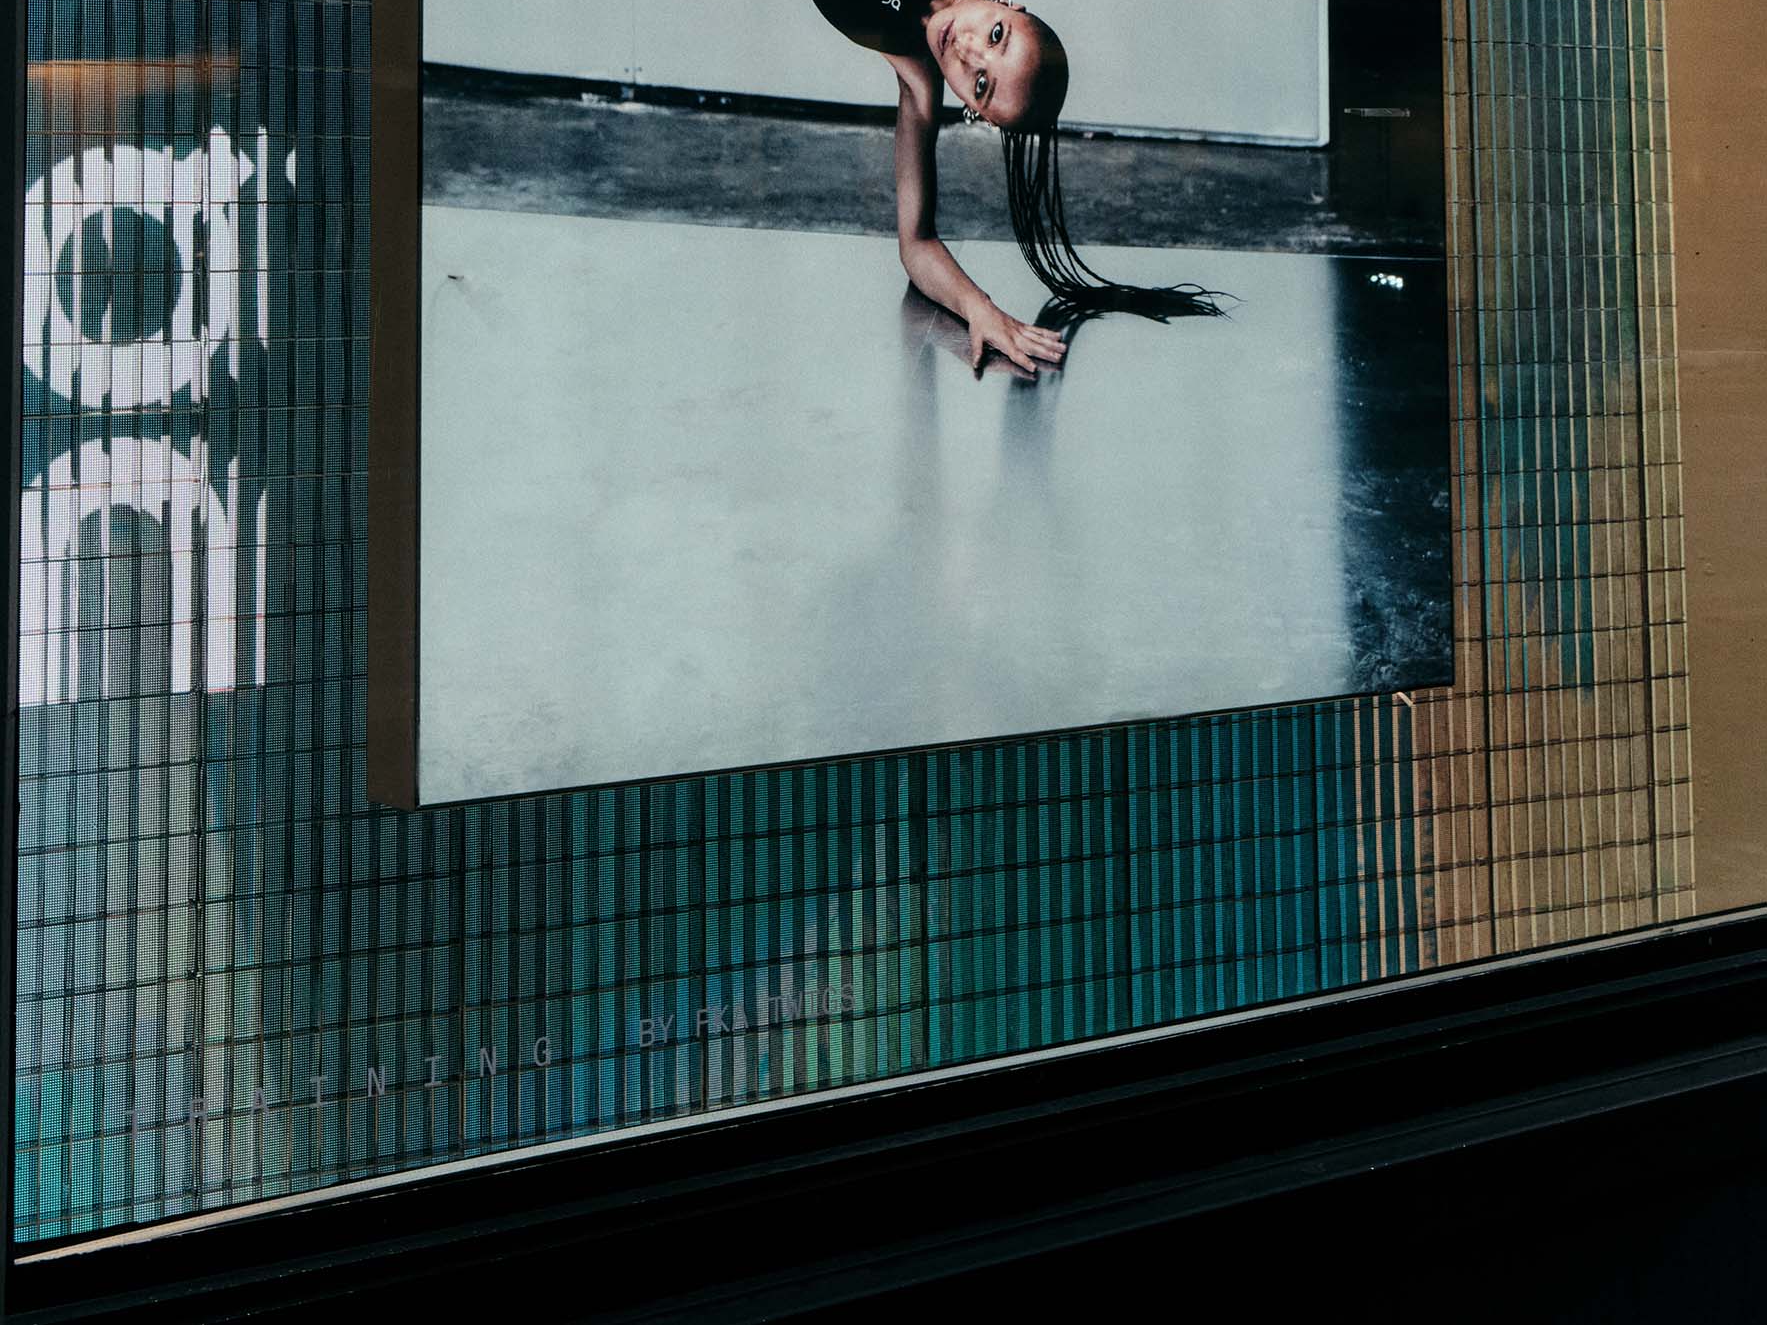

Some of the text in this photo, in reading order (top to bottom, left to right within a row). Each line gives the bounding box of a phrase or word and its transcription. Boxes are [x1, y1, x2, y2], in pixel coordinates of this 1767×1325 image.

[125, 983, 857, 1141] TRAINING BY FKA TWIGS
